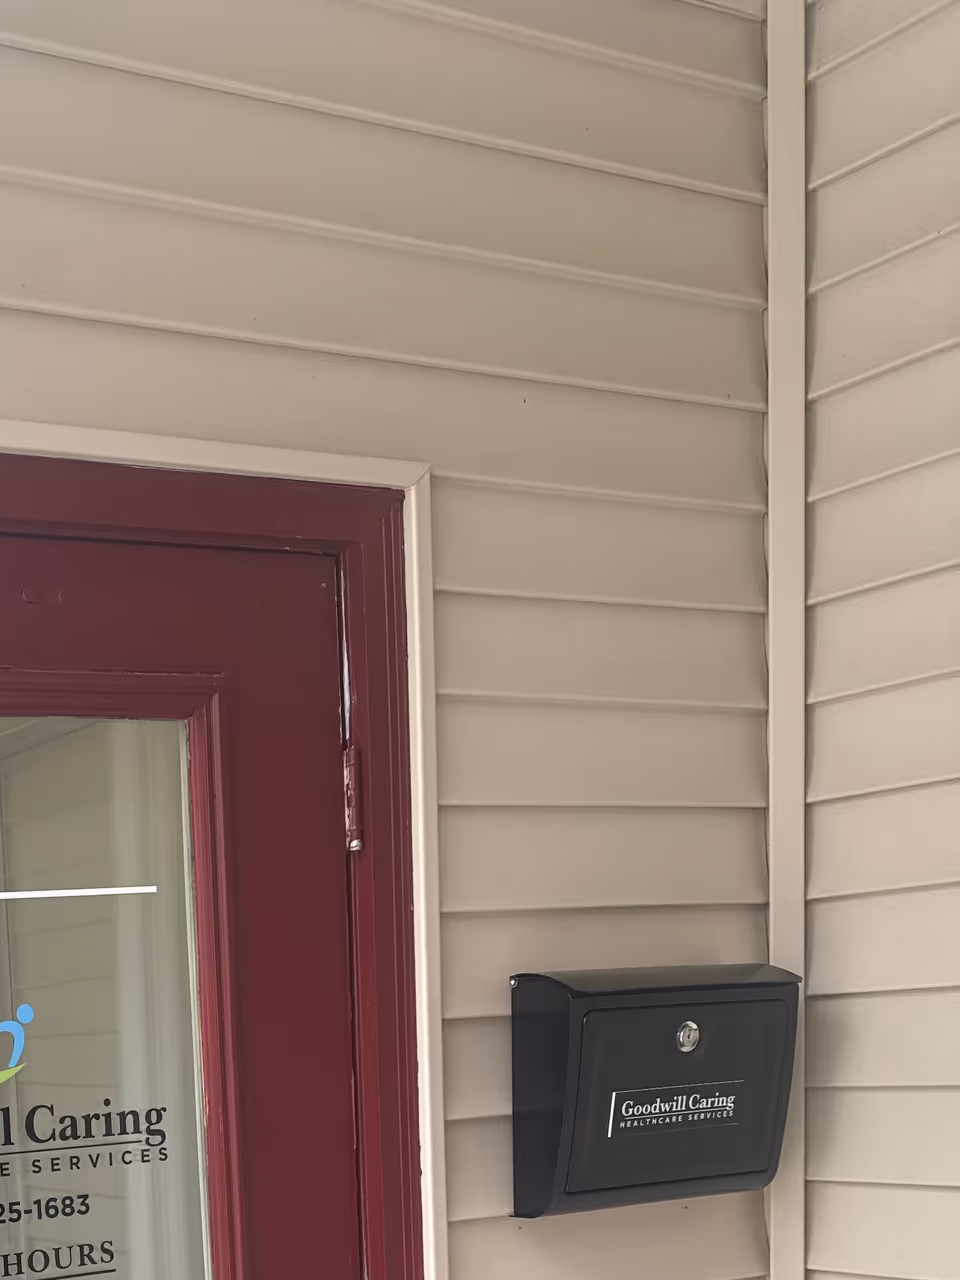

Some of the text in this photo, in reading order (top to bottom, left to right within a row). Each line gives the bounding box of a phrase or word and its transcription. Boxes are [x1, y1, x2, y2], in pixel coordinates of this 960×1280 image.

[622, 1092, 736, 1117] Goodwill Caring
[24, 1098, 167, 1146] Caring
[620, 1110, 734, 1129] HEALTHCARE SERVICES
[30, 1146, 169, 1174] SERVICES
[1, 1240, 115, 1278] HOURS
